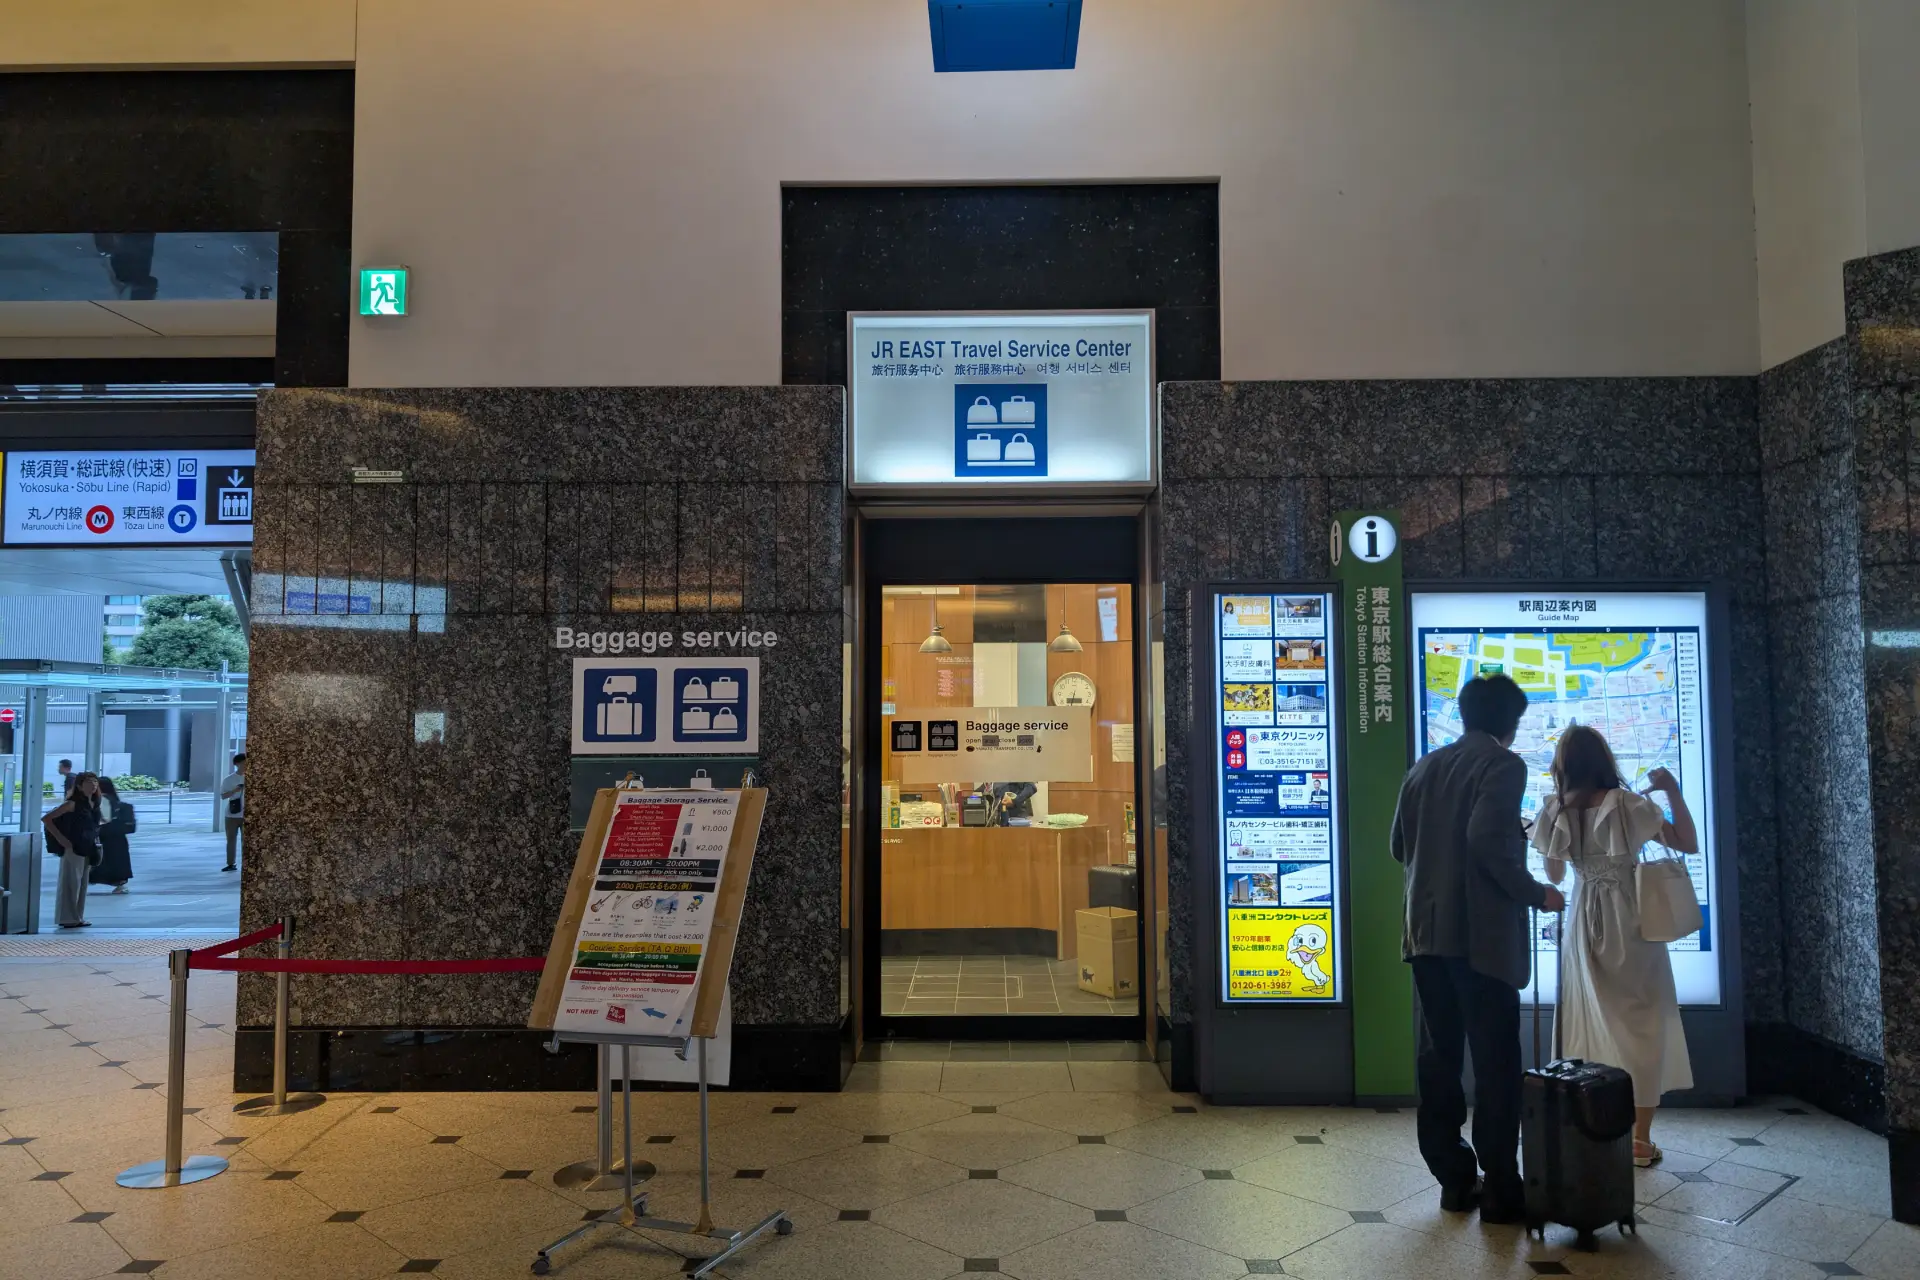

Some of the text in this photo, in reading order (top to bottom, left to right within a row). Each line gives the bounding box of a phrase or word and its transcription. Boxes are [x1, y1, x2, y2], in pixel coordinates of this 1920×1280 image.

[871, 339, 1132, 359] JR EAST Travel Service Center
[871, 363, 1026, 377] 旅行服务中心 旅行服務中心
[1036, 361, 1132, 375] 여행 서비스 센터
[180, 463, 195, 473] JO
[107, 482, 129, 493] Line
[133, 482, 171, 494] (Rapid)
[27, 506, 83, 520] 丸ノ内線
[122, 506, 165, 520] 東西線
[178, 514, 187, 524] T
[94, 514, 106, 525] M
[21, 522, 83, 531] Marunouchi Line
[147, 522, 165, 531] Line
[1518, 600, 1598, 613] 駅周辺案内図
[1537, 613, 1580, 623] Guide Map
[556, 626, 778, 654] Baggage service
[1357, 624, 1368, 665] Station
[1371, 586, 1393, 722] 東京駅総合案内
[1225, 659, 1271, 668] 大手町皮膚科
[1357, 667, 1369, 734] Information
[966, 719, 1069, 733] Baggage service
[1260, 731, 1325, 741] 東京クリニック
[619, 859, 652, 867] 08:30AM
[651, 868, 662, 876] day
[663, 868, 678, 876] pick
[1231, 981, 1292, 989] 0120-61-3987
